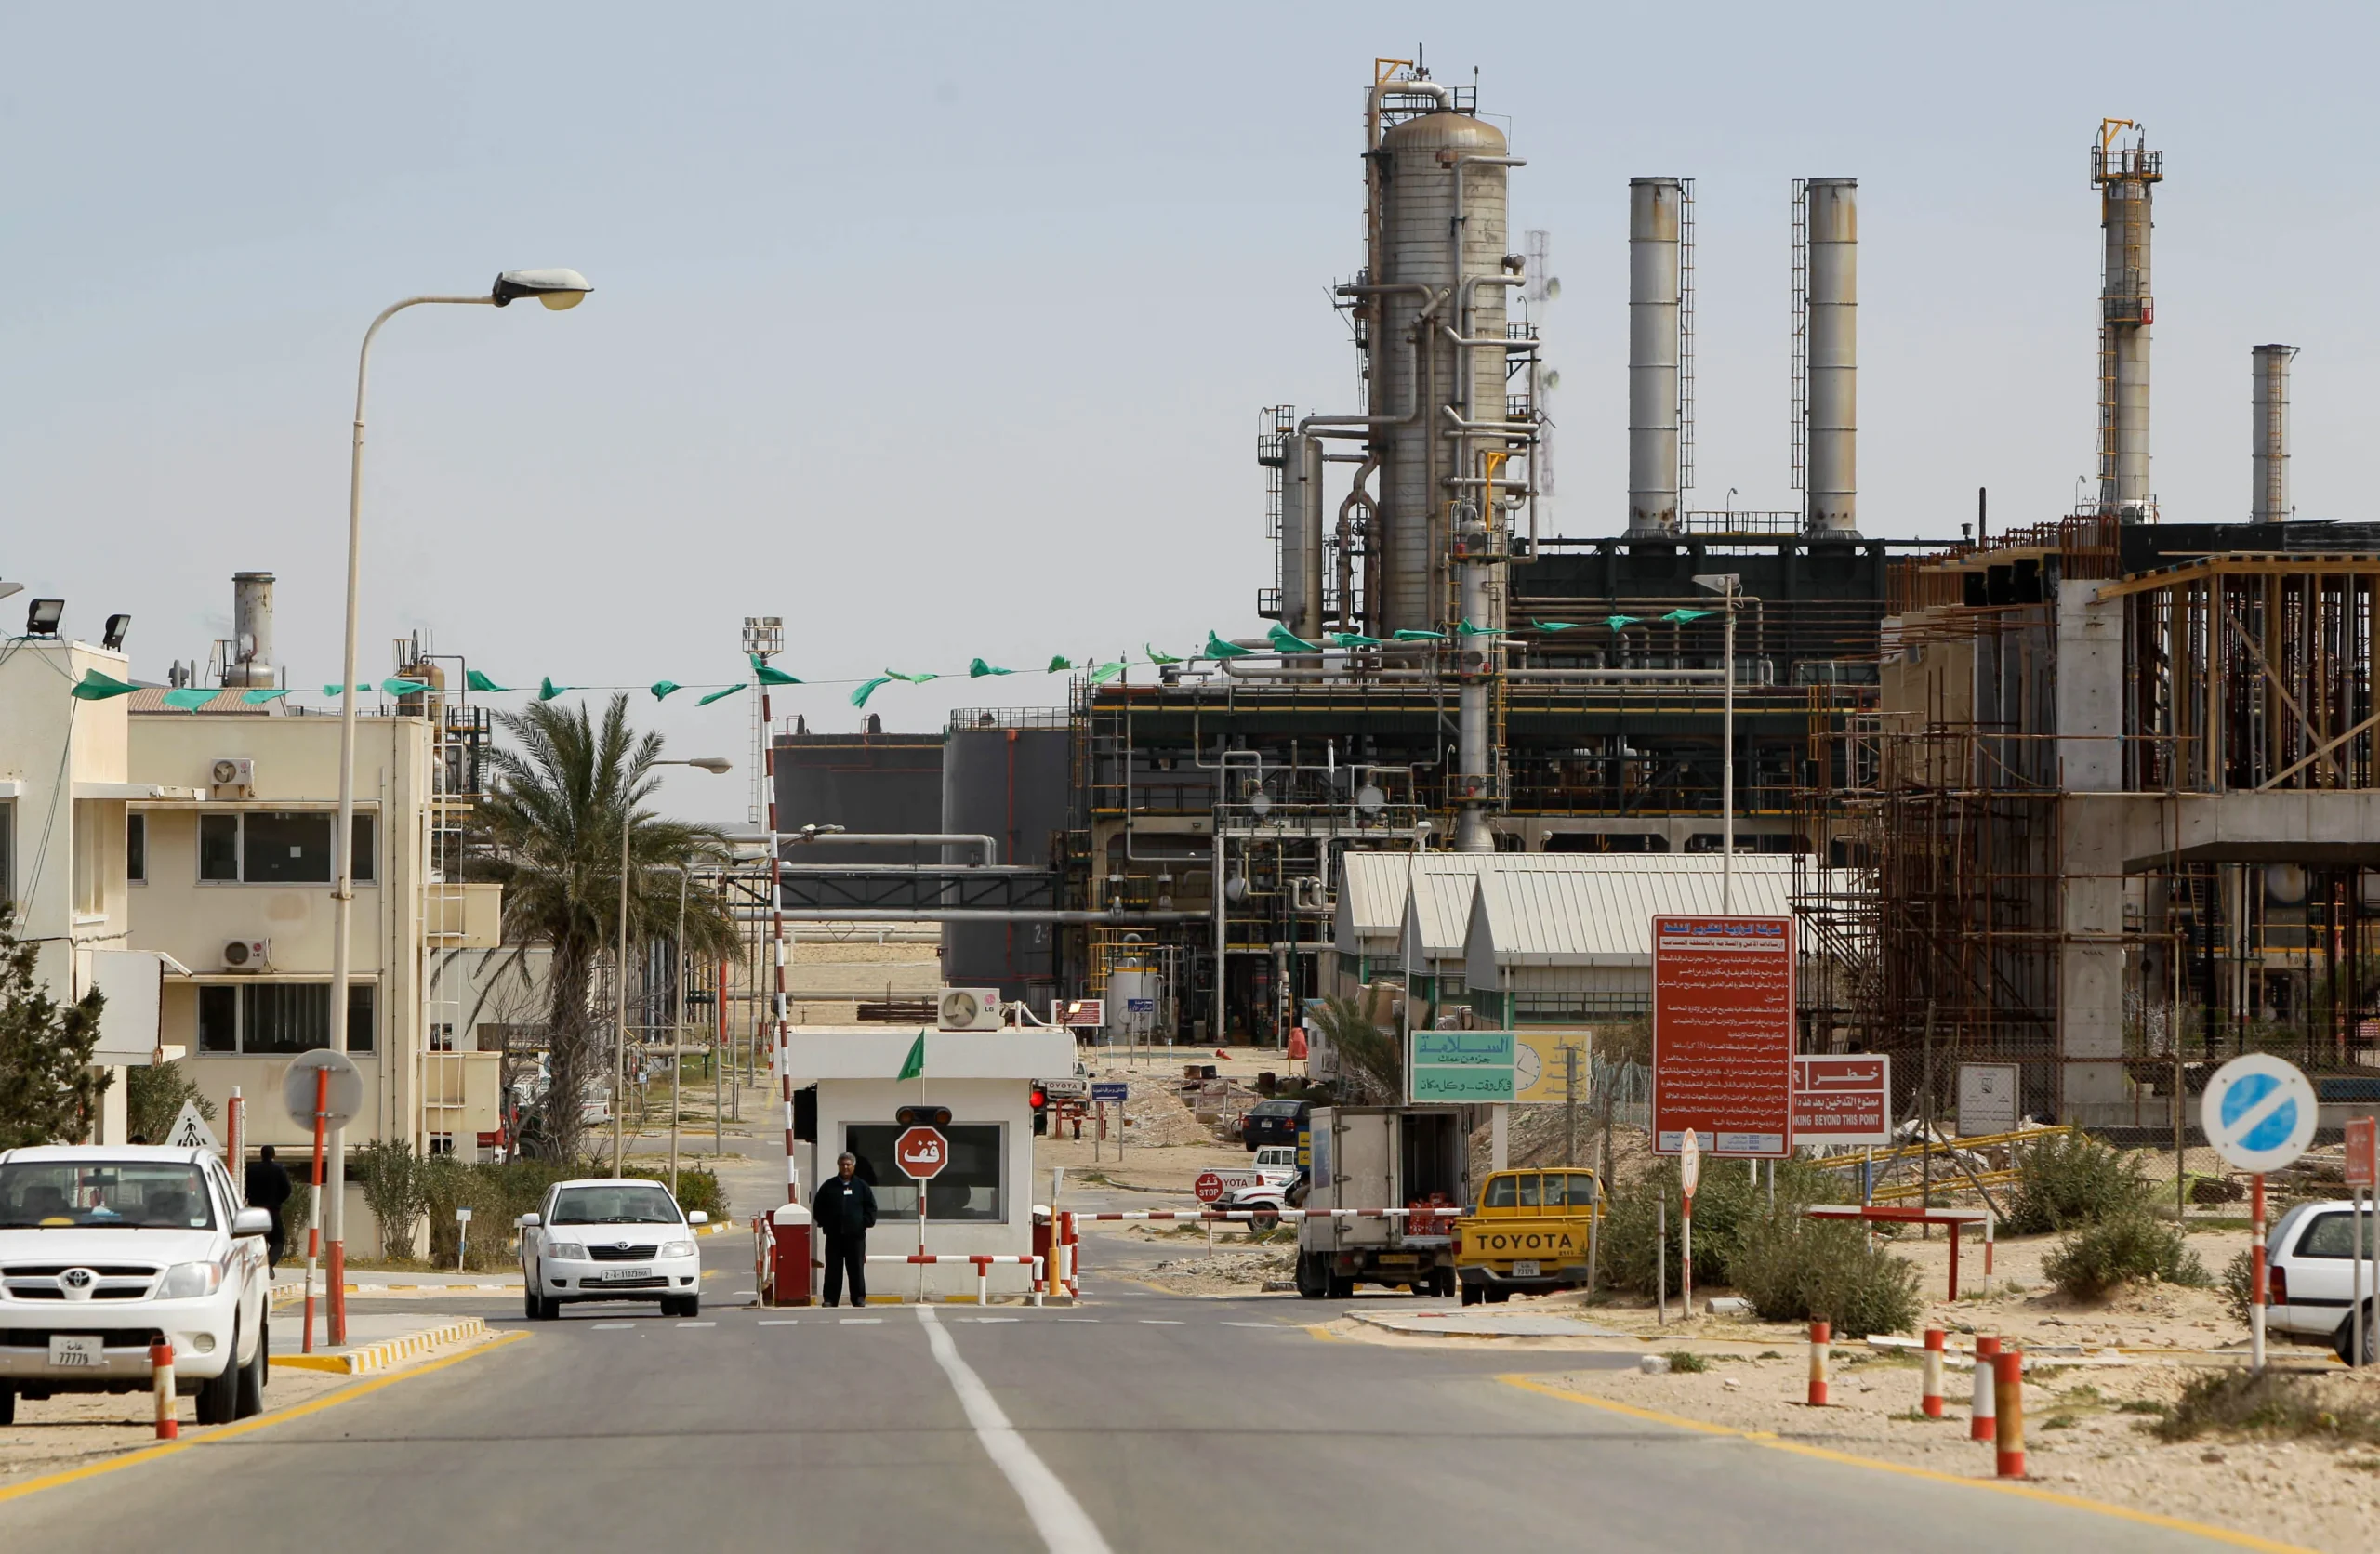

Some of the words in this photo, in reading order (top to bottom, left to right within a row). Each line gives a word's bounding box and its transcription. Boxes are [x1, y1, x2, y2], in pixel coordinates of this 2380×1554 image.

[1419, 1035, 1509, 1053] السلامة
[1813, 1065, 1879, 1086] خطر
[1420, 1078, 1439, 1090] مكان
[1474, 1079, 1493, 1091] وقت
[1812, 1097, 1825, 1111] بعد
[1825, 1095, 1858, 1111] التدخين
[1857, 1096, 1879, 1111] ممنوع
[1793, 1114, 1812, 1126] KING
[1814, 1115, 1841, 1126] BEYOND
[1842, 1114, 1858, 1125] THIS
[1859, 1114, 1880, 1126] POINT
[904, 1140, 940, 1163] قف
[1198, 1176, 1219, 1186] قف
[1223, 1179, 1248, 1187] YOTA
[1198, 1189, 1219, 1197] STOP
[1476, 1233, 1573, 1250] TOYOTA
[59, 1352, 89, 1365] 77779
